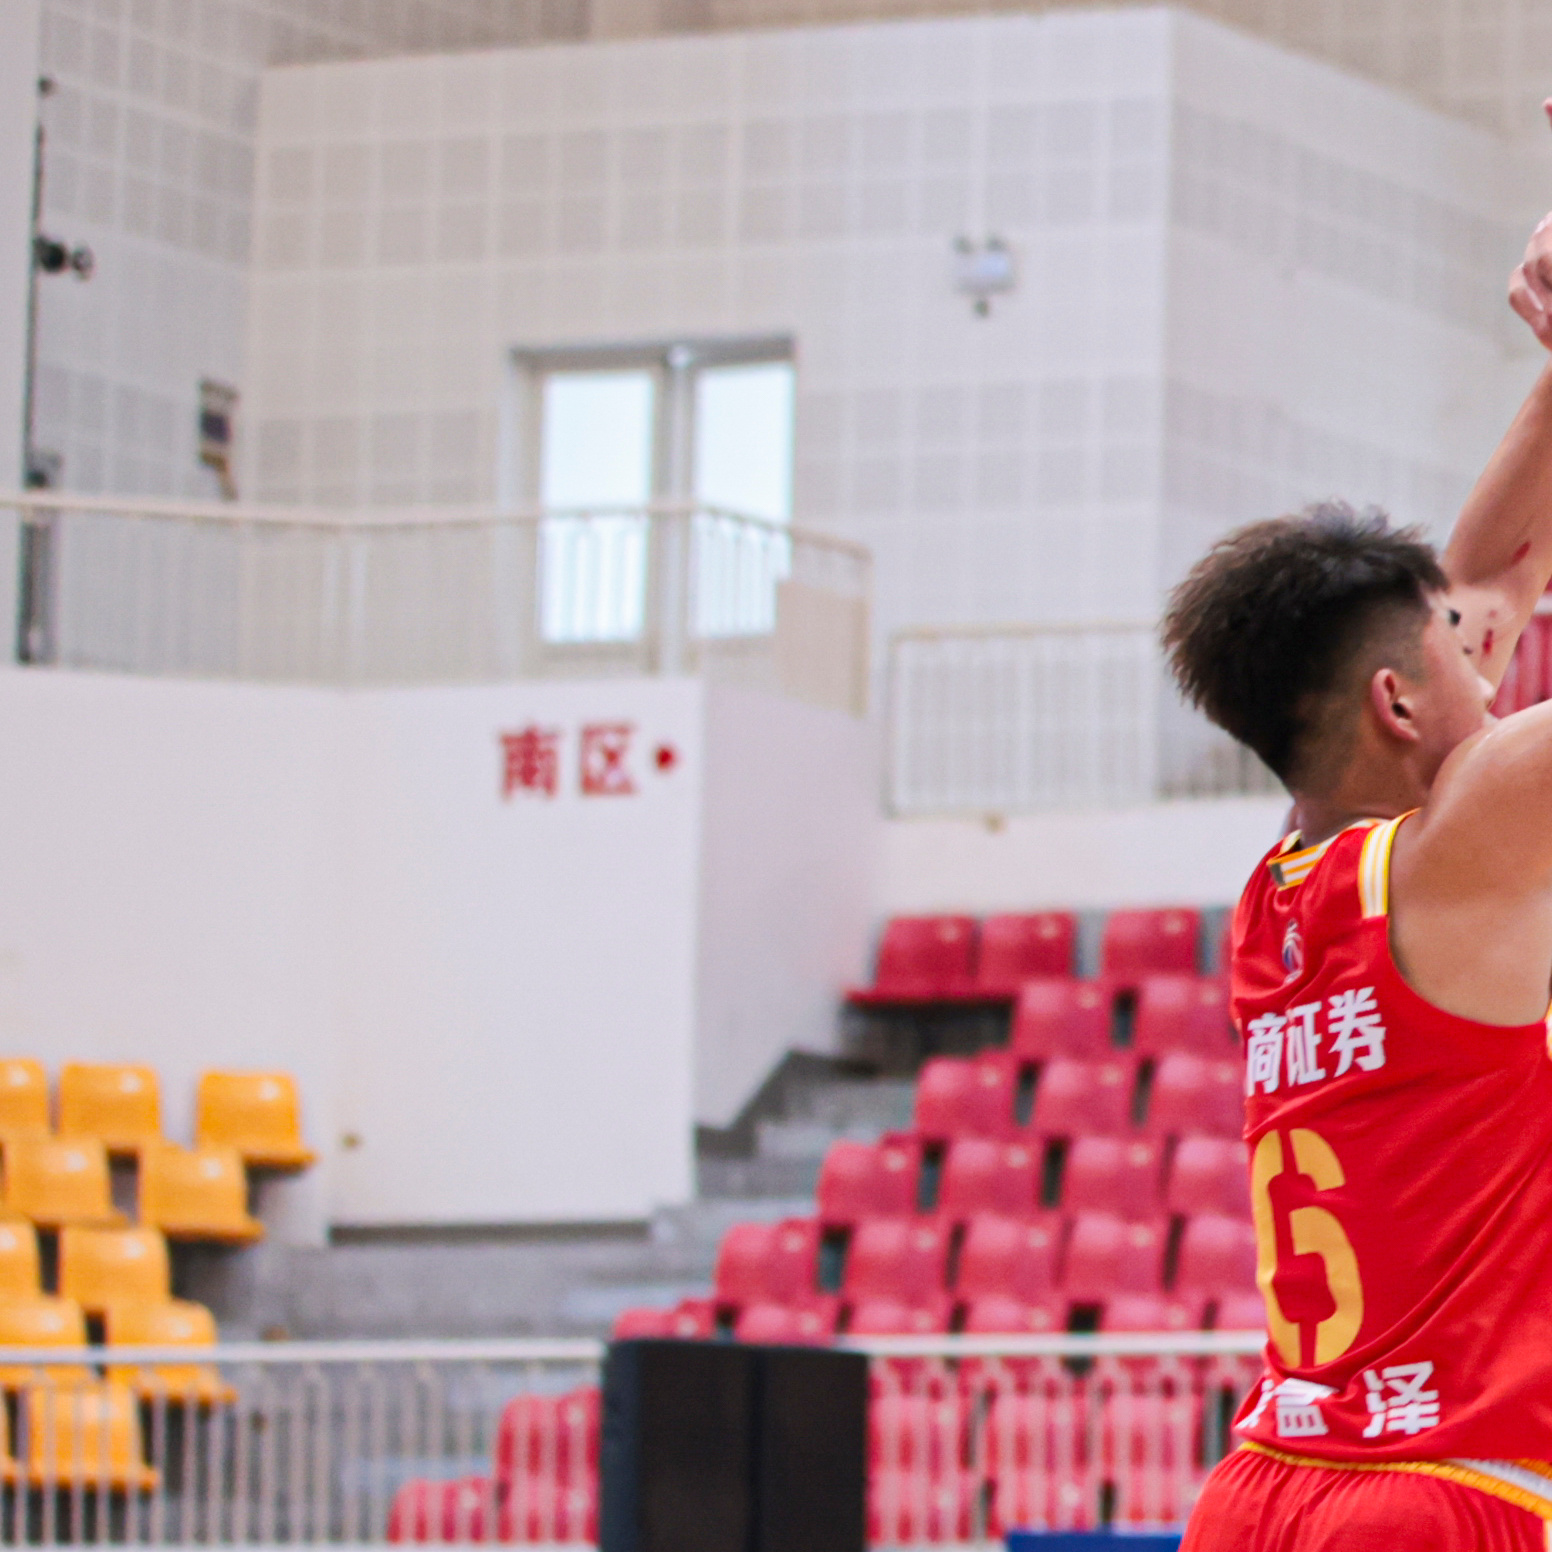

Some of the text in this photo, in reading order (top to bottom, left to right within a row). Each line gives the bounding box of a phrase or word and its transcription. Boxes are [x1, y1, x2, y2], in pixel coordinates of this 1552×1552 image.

[498, 720, 638, 803] 南区
[1246, 985, 1388, 1098] 商证券
[1250, 1127, 1364, 1370] 6
